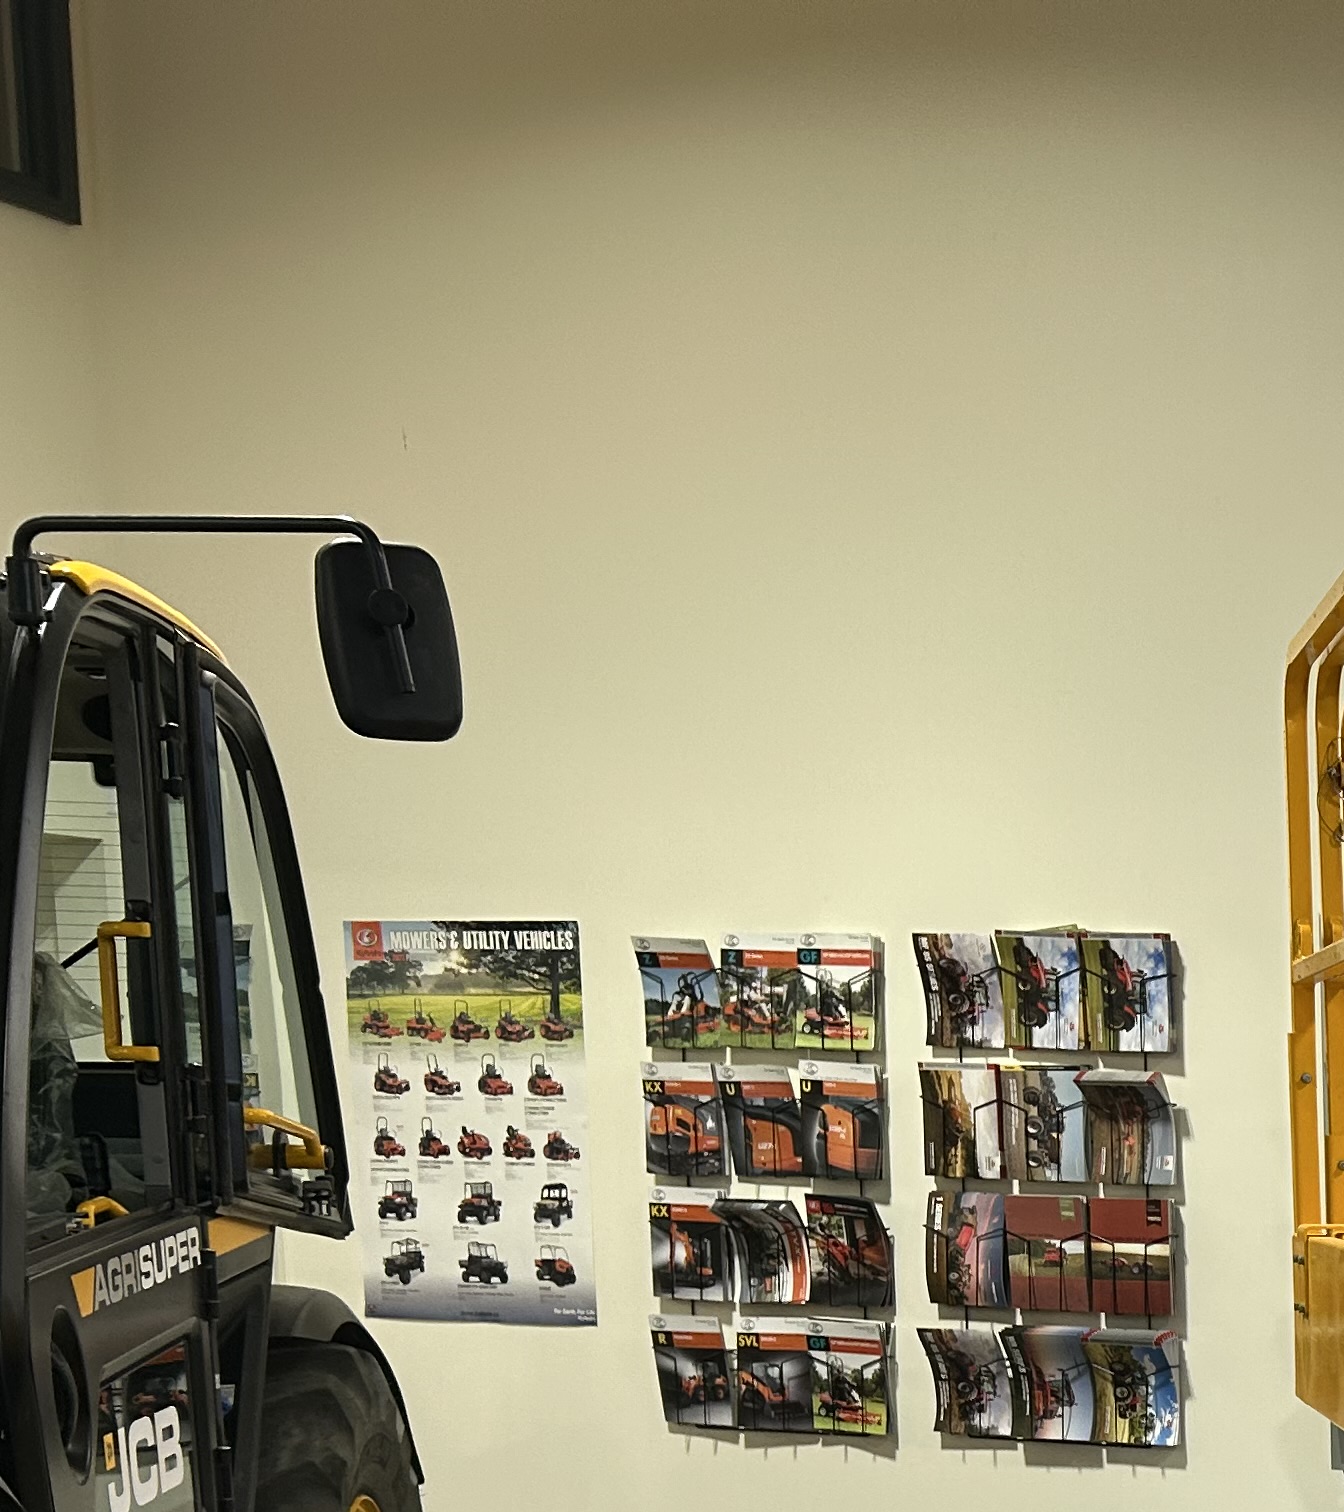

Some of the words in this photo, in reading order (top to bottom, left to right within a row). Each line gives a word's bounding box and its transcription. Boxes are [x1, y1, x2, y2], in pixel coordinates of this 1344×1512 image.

[389, 930, 447, 951] MOWERS
[450, 930, 460, 950] &
[462, 930, 510, 950] UTILITY
[513, 930, 575, 951] VEHICLES
[800, 950, 819, 963] GF
[644, 1081, 664, 1094] KX
[650, 1204, 670, 1218] KX
[738, 1334, 759, 1348] SVL
